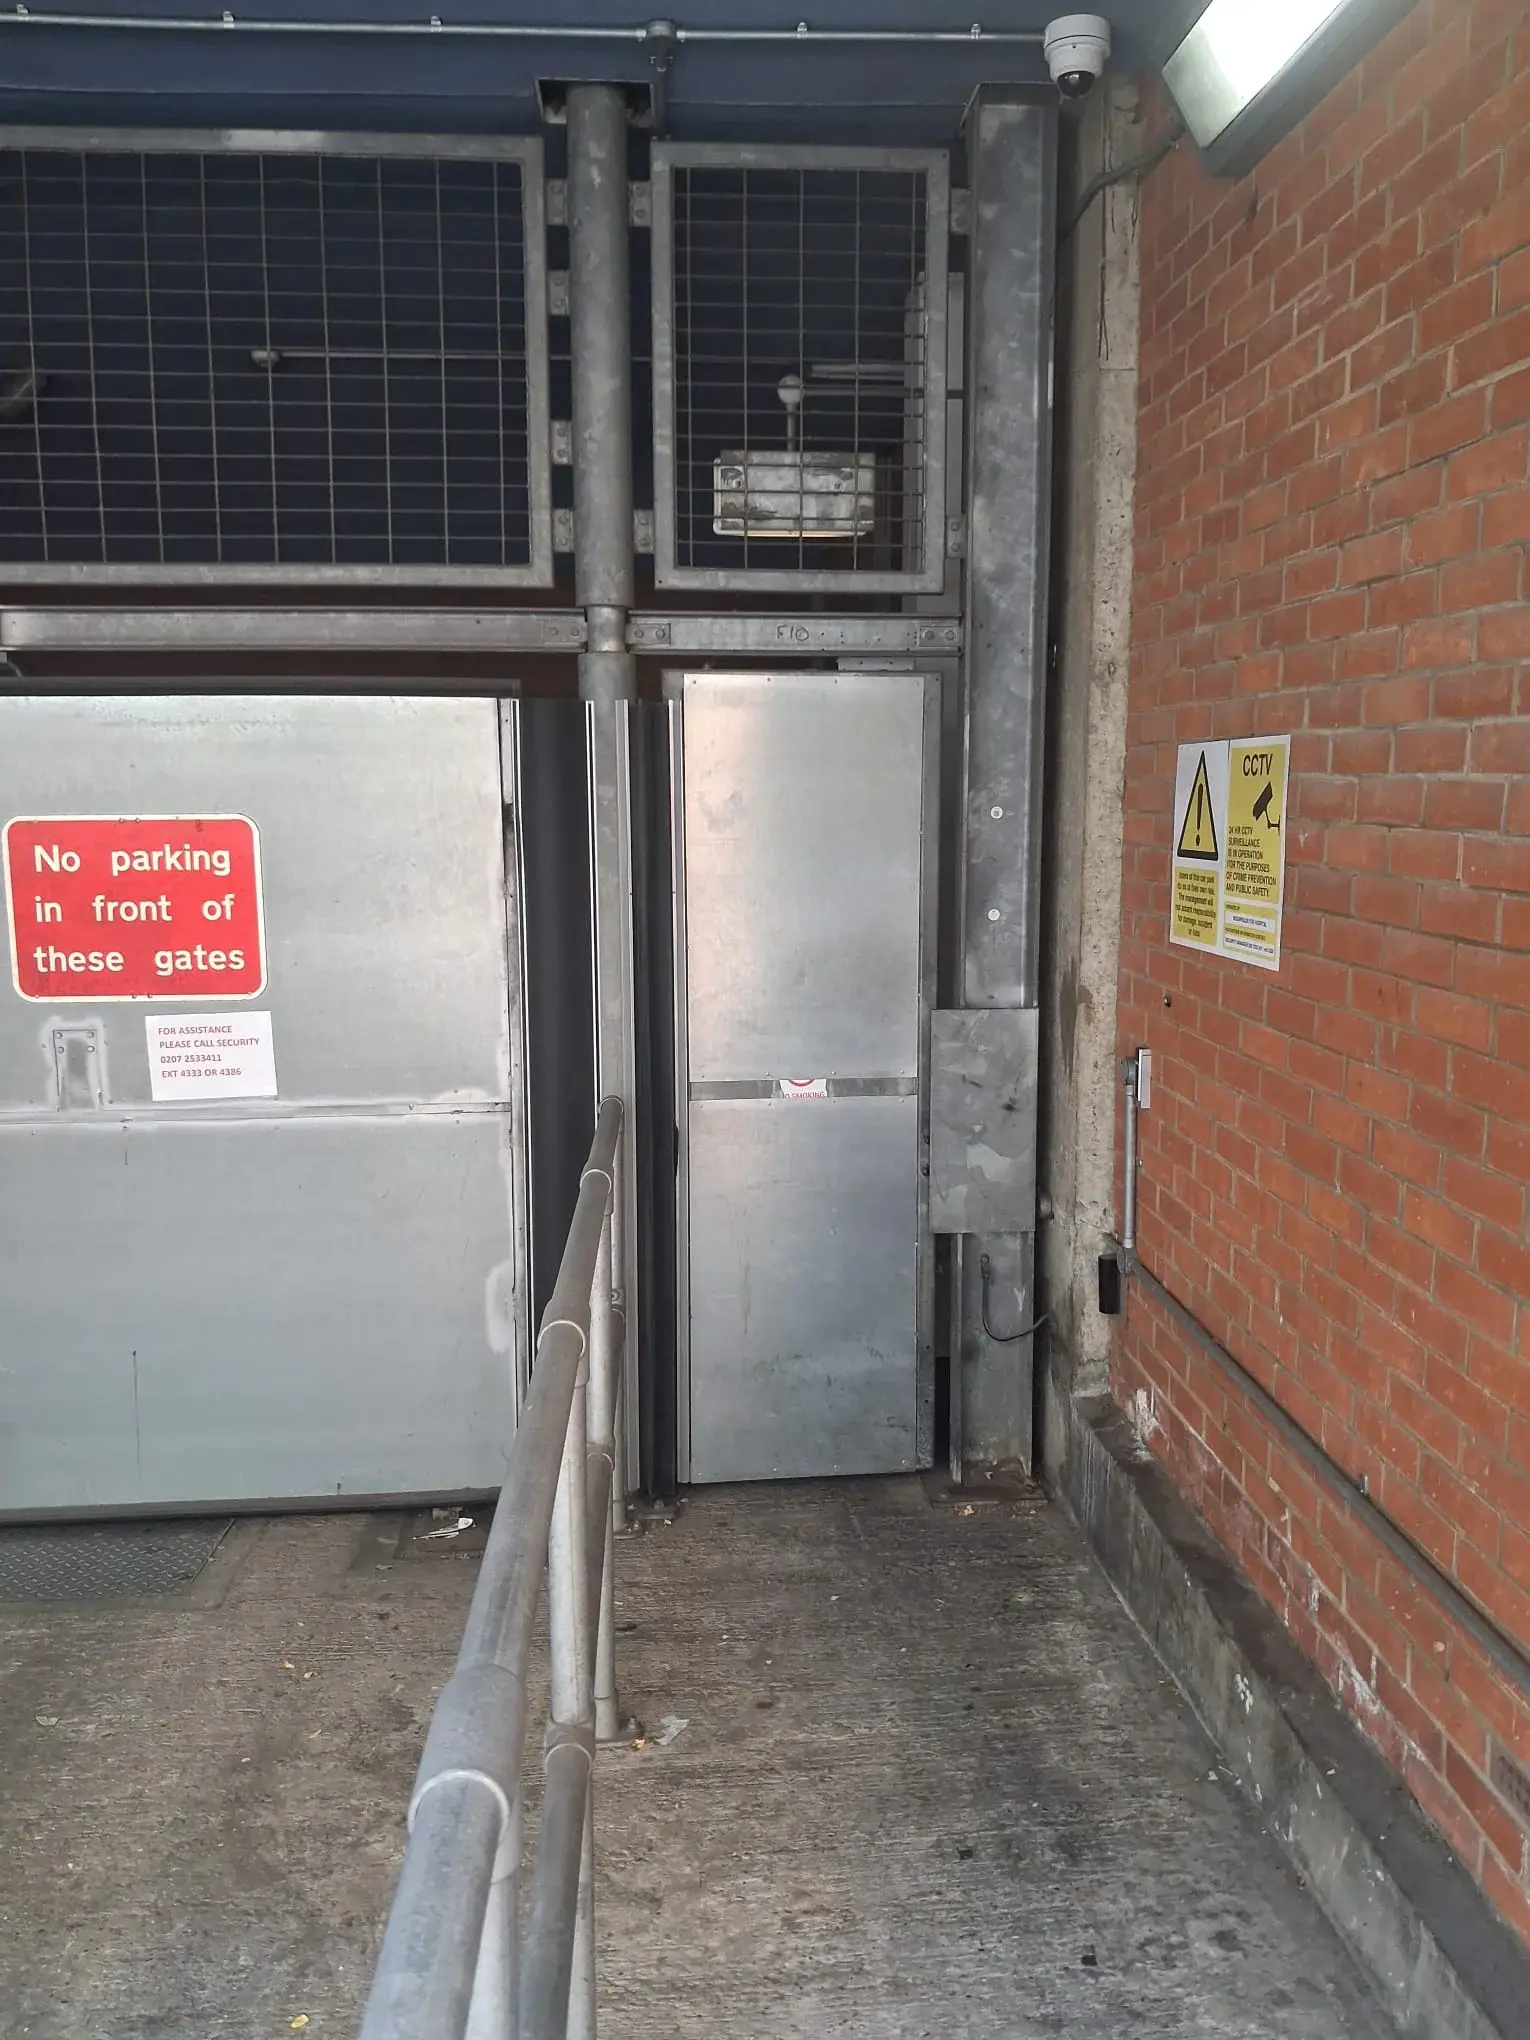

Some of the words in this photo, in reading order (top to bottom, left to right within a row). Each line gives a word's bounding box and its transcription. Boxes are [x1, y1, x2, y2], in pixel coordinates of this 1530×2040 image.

[1243, 753, 1274, 777] CCTV
[1241, 826, 1253, 835] CCTV
[1228, 837, 1260, 848] SURVEILLANCE
[33, 844, 81, 872] No
[110, 843, 231, 877] parking
[1227, 848, 1232, 857] IS
[1233, 849, 1237, 857] IN
[1238, 849, 1264, 860] OPERATION
[1227, 860, 1235, 869] FOR
[1235, 861, 1245, 870] THE
[1246, 862, 1270, 873] PURPOSES
[1226, 871, 1232, 880] OF
[1233, 872, 1247, 882] CRIME
[1247, 874, 1277, 886] PREVENTION
[1226, 882, 1235, 892] AND
[1236, 884, 1251, 894] PUBLIC
[35, 895, 63, 922] in
[92, 894, 173, 921] front
[202, 893, 236, 921] of
[33, 945, 125, 973] these
[154, 944, 245, 977] gates
[158, 1027, 176, 1036] FOR
[179, 1025, 232, 1035] ASSISTANCE
[159, 1039, 191, 1049] PLEASE
[193, 1039, 215, 1048] CALL
[216, 1038, 260, 1047] SECURITY
[160, 1055, 182, 1064] 0207
[184, 1053, 222, 1063] 2533411
[162, 1070, 178, 1078] EXT
[180, 1069, 202, 1078] 4333
[204, 1068, 218, 1077] OR
[219, 1067, 242, 1076] 4386
